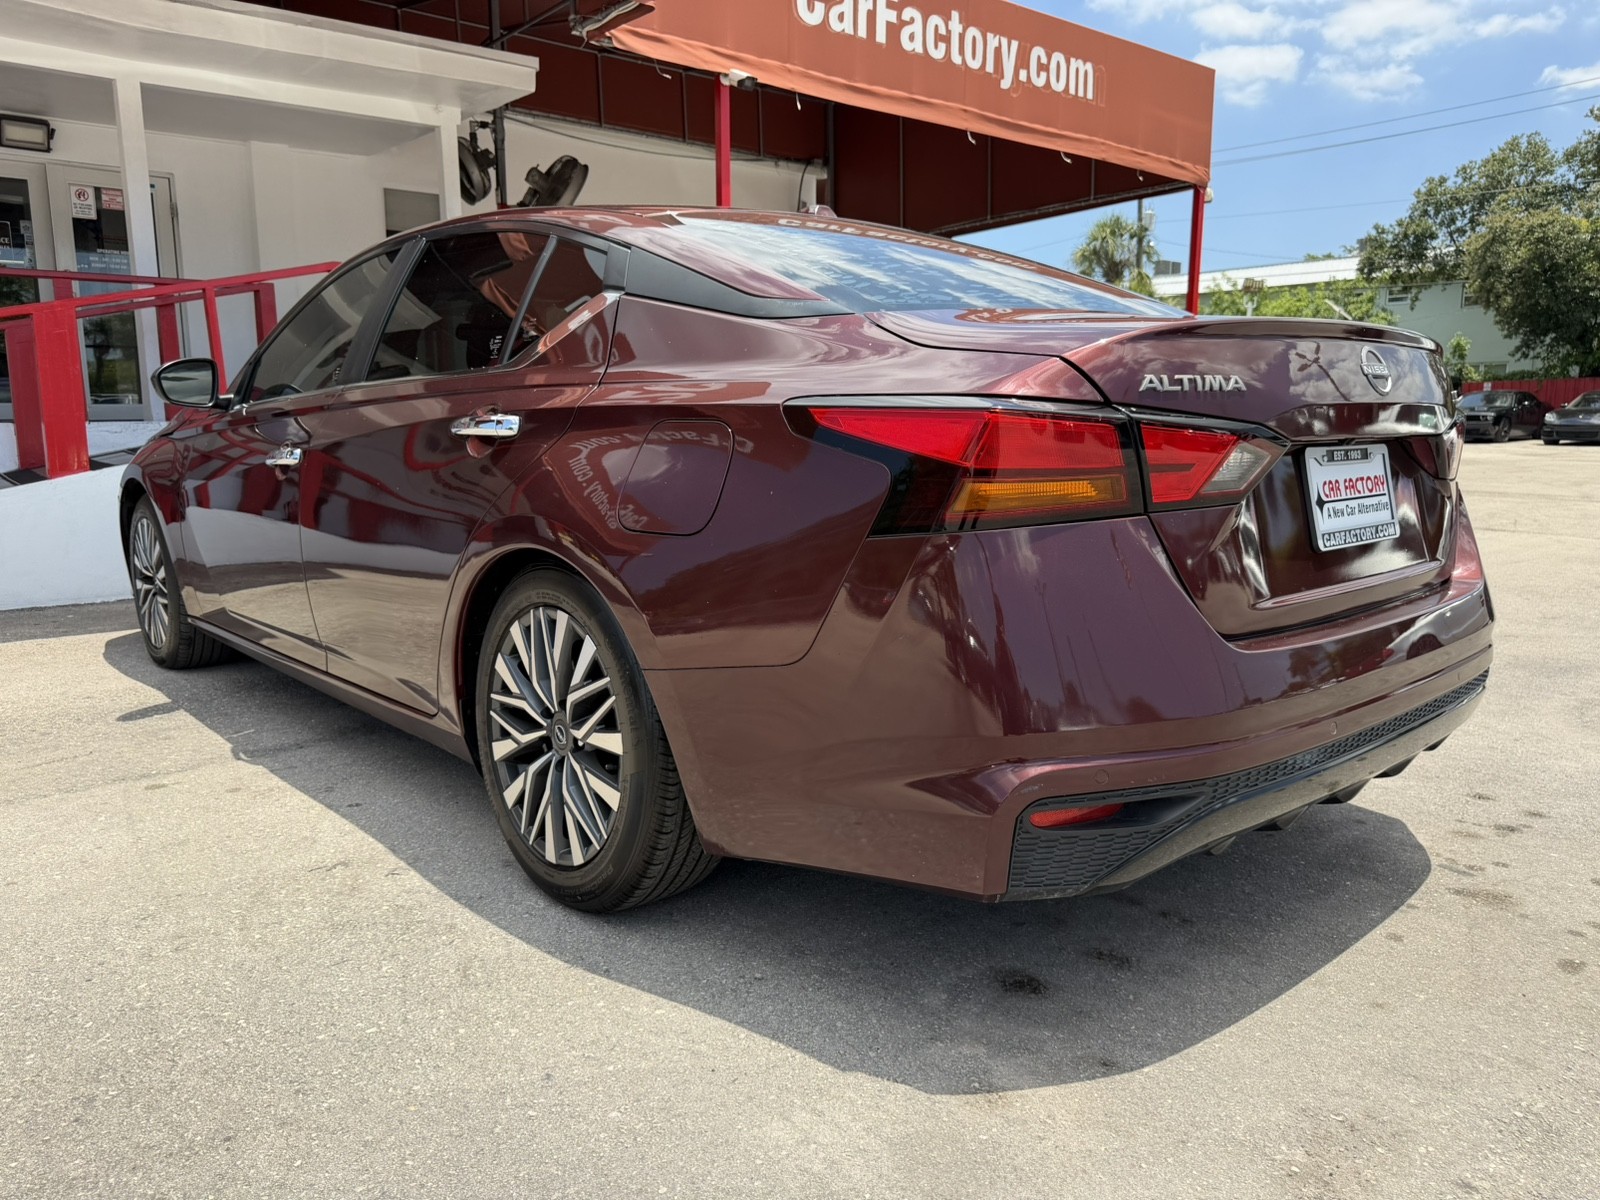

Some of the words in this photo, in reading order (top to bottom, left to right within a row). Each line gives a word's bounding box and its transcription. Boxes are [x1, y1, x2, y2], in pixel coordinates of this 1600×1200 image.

[795, 0, 1094, 99] CarFactory.com
[1139, 374, 1247, 392] ALTIMA
[1333, 451, 1347, 461] EST.
[1347, 450, 1362, 460] 1993
[1322, 479, 1342, 499] CAR
[1343, 474, 1386, 497] FACTORY
[1327, 507, 1332, 519] A
[1332, 506, 1345, 519] New
[1345, 504, 1356, 517] Car
[1357, 499, 1389, 514] Alternative
[1324, 523, 1396, 548] CARFACTORY.COM
